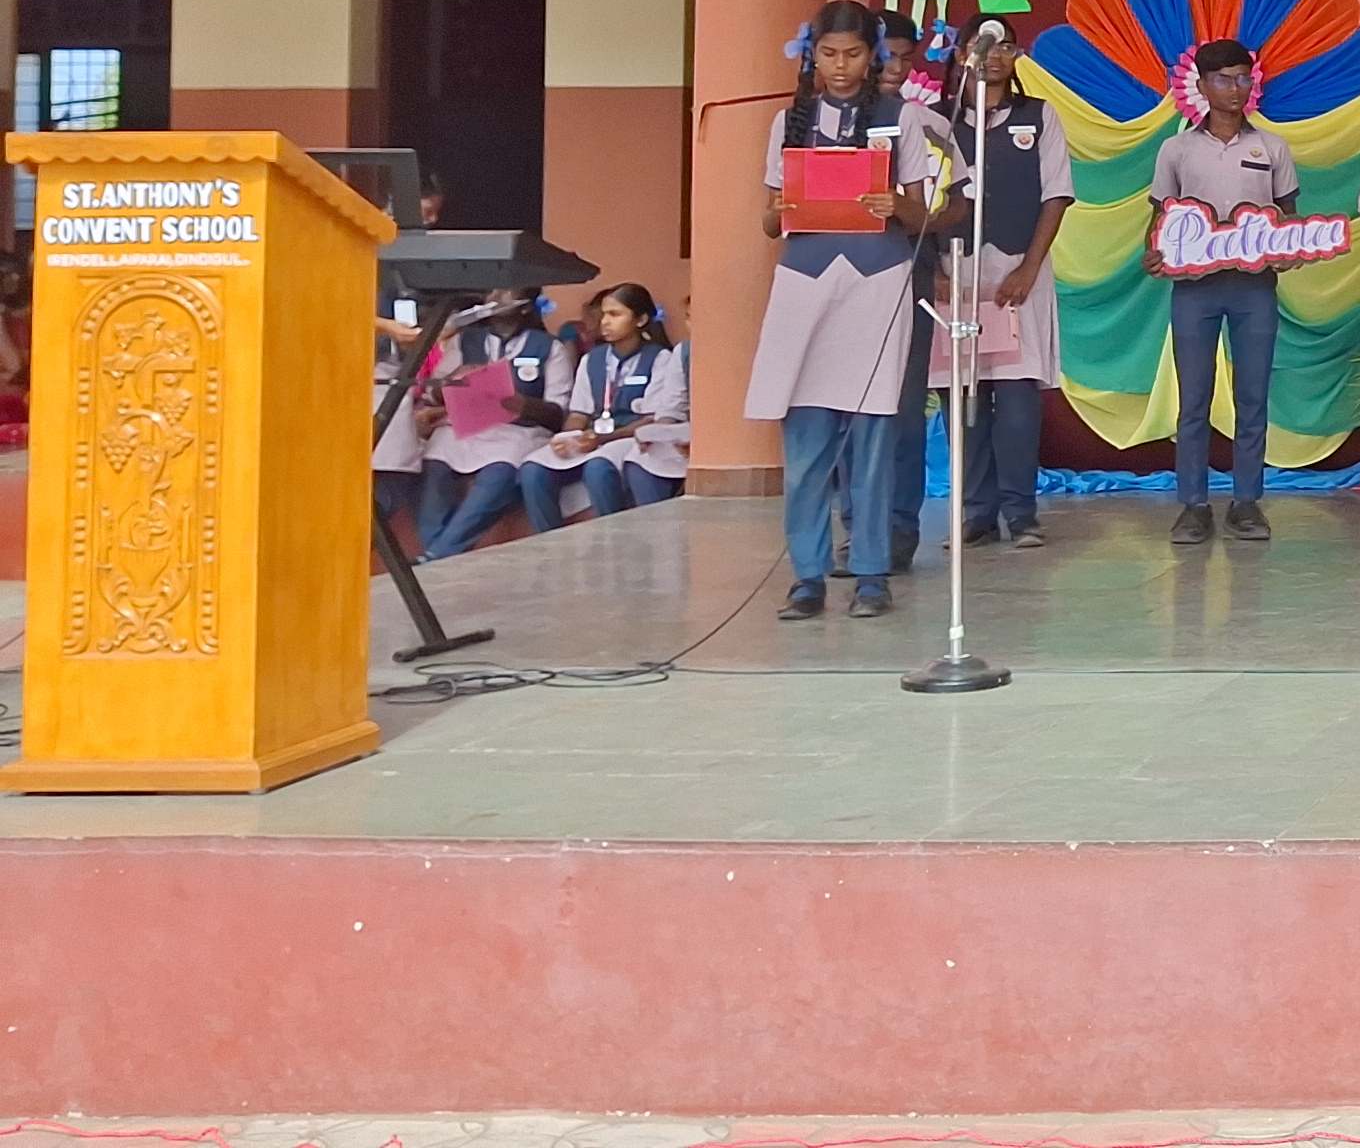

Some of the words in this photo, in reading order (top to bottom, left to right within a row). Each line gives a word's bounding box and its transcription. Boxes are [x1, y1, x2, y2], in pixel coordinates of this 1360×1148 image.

[63, 180, 241, 209] ST.ANTHONY'S
[43, 217, 155, 243] CONVENT
[161, 216, 259, 242] SCHOOL
[1166, 207, 1343, 266] Patience
